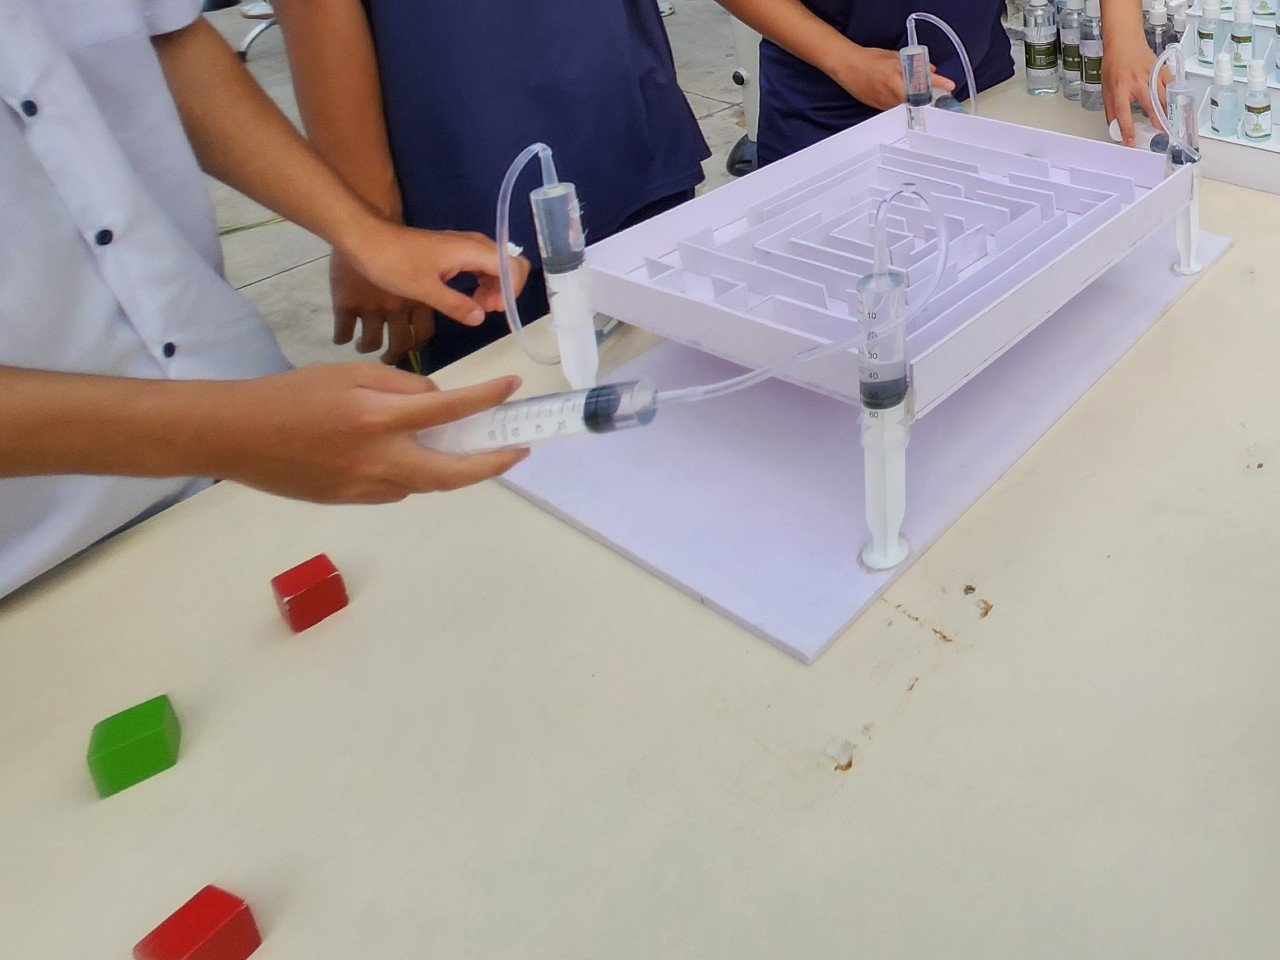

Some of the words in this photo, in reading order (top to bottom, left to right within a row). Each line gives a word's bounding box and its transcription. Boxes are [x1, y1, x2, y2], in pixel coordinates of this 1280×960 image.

[867, 312, 877, 320] 10
[868, 352, 878, 360] 30
[868, 372, 879, 380] 40
[869, 411, 879, 419] 60
